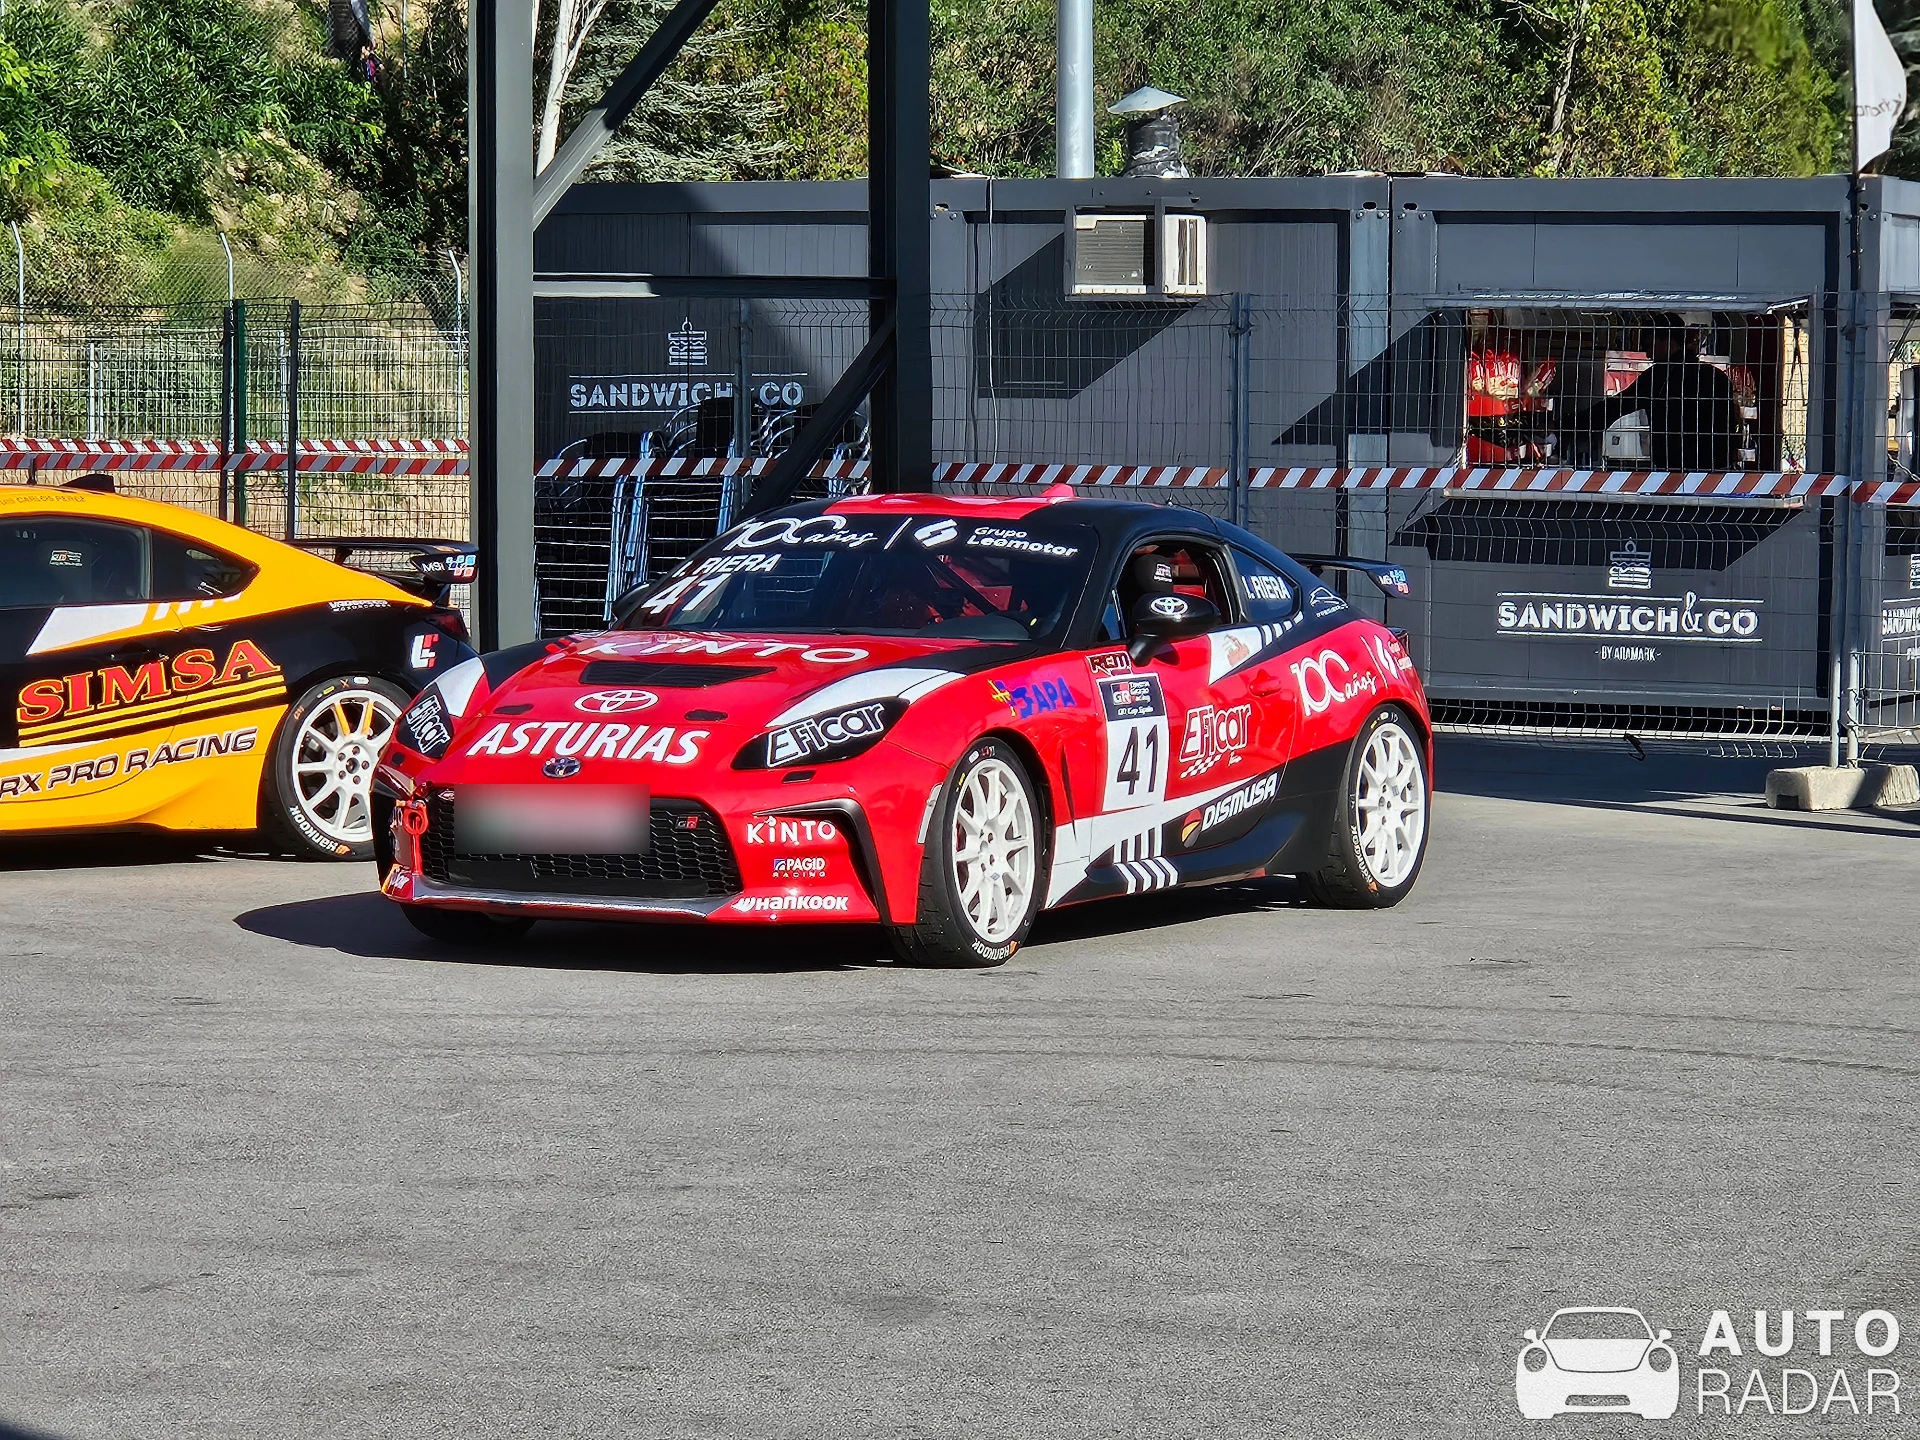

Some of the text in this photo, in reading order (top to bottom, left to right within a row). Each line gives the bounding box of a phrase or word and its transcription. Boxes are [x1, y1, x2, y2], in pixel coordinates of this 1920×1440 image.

[974, 526, 1028, 539] Grupo
[692, 553, 783, 574] RIERA
[641, 573, 732, 615] 41
[1250, 574, 1292, 600] RIERA
[16, 639, 282, 723] SIMSA
[47, 753, 120, 790] PRO
[124, 726, 259, 774] RACING
[465, 720, 712, 765] ASTURIAS
[1116, 723, 1160, 796] 41
[1200, 772, 1279, 832] DISMUSA
[772, 871, 827, 879] RACING
[785, 857, 827, 871] PAGID
